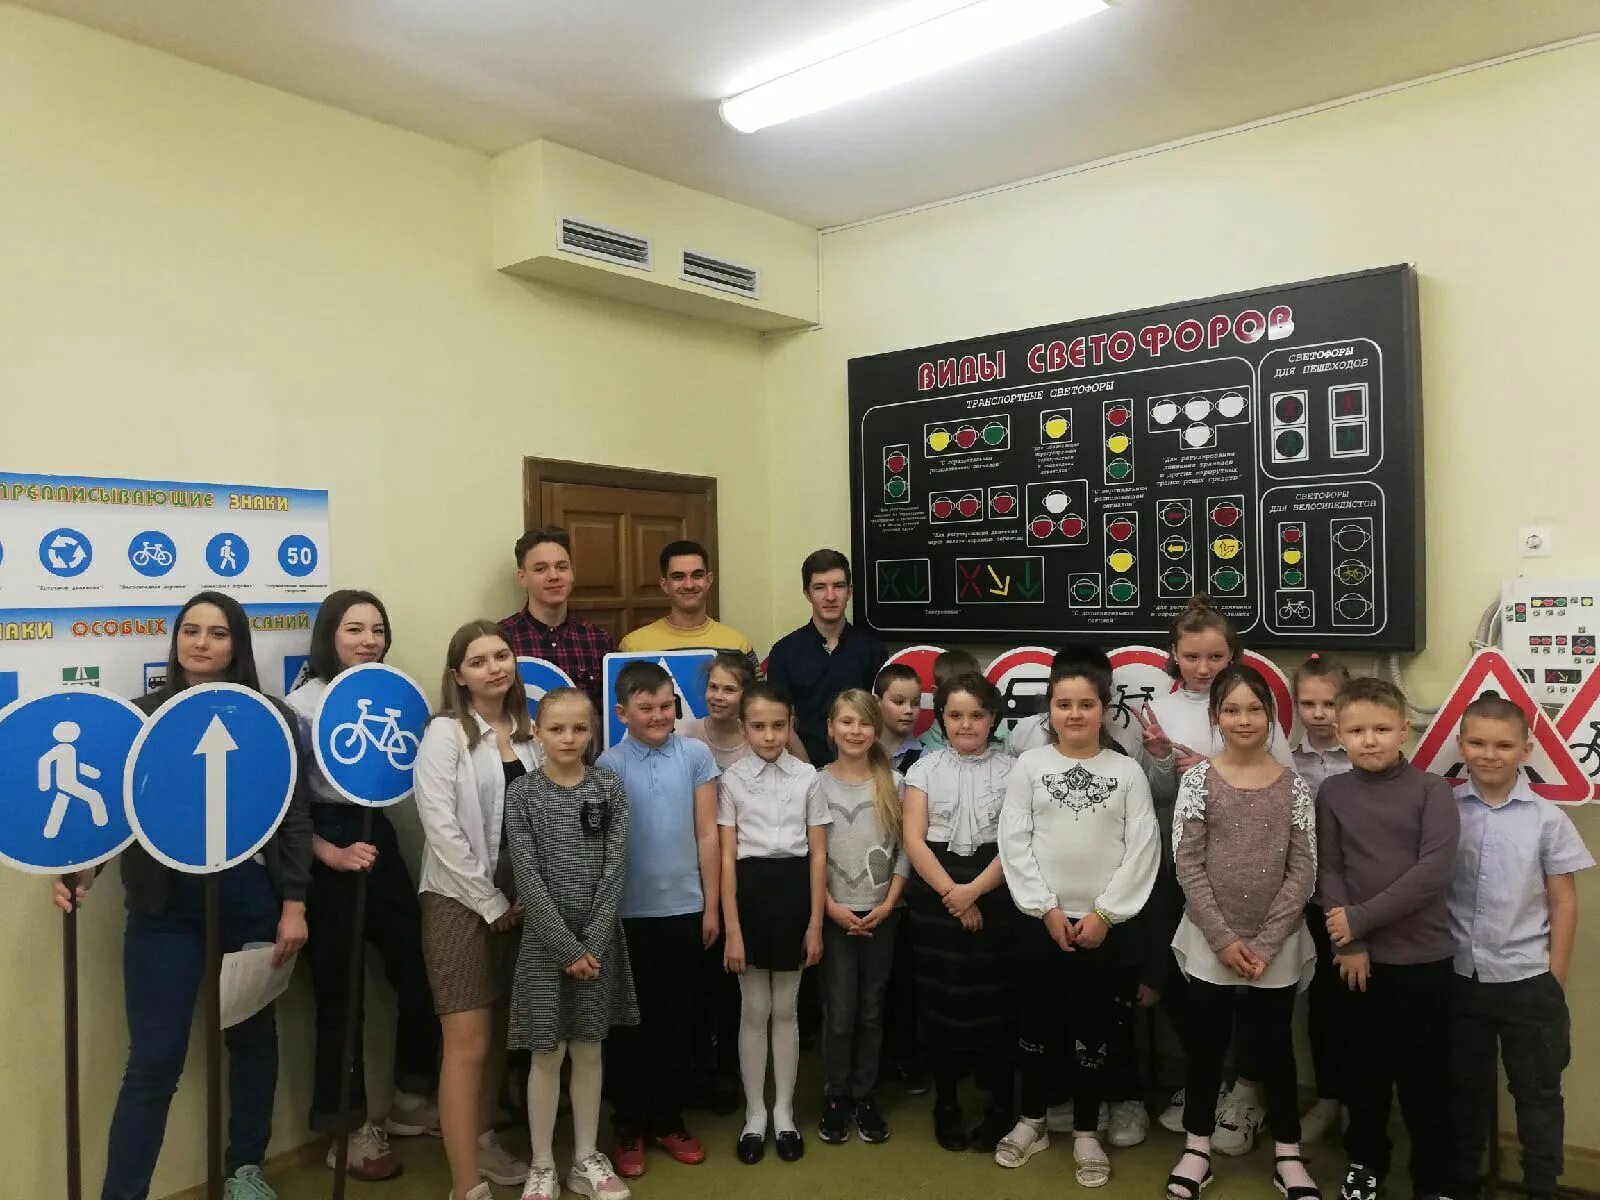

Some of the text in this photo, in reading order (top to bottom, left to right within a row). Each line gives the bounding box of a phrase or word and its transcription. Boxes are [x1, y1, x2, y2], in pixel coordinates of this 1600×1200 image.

[918, 305, 1295, 391] ВИДЫ СВЕТОФОРОВ
[1288, 347, 1354, 363] СВЕТОФОРЫ
[1274, 358, 1369, 378] ДЛЯ ПЕШЕХОДОВ
[966, 380, 1115, 409] ТРАНСПОРТНЫЕ СВЕТОФОРЫ
[229, 494, 289, 511] ЗНАКИ
[1295, 490, 1350, 500] СВЕТОФОРЫ
[1269, 499, 1377, 513] ДЛЯ ВЕЛОСИПЕДИСТОВ
[287, 547, 312, 565] 50
[0, 609, 310, 640] АКИ ОСОБЫХ САНИЙ
